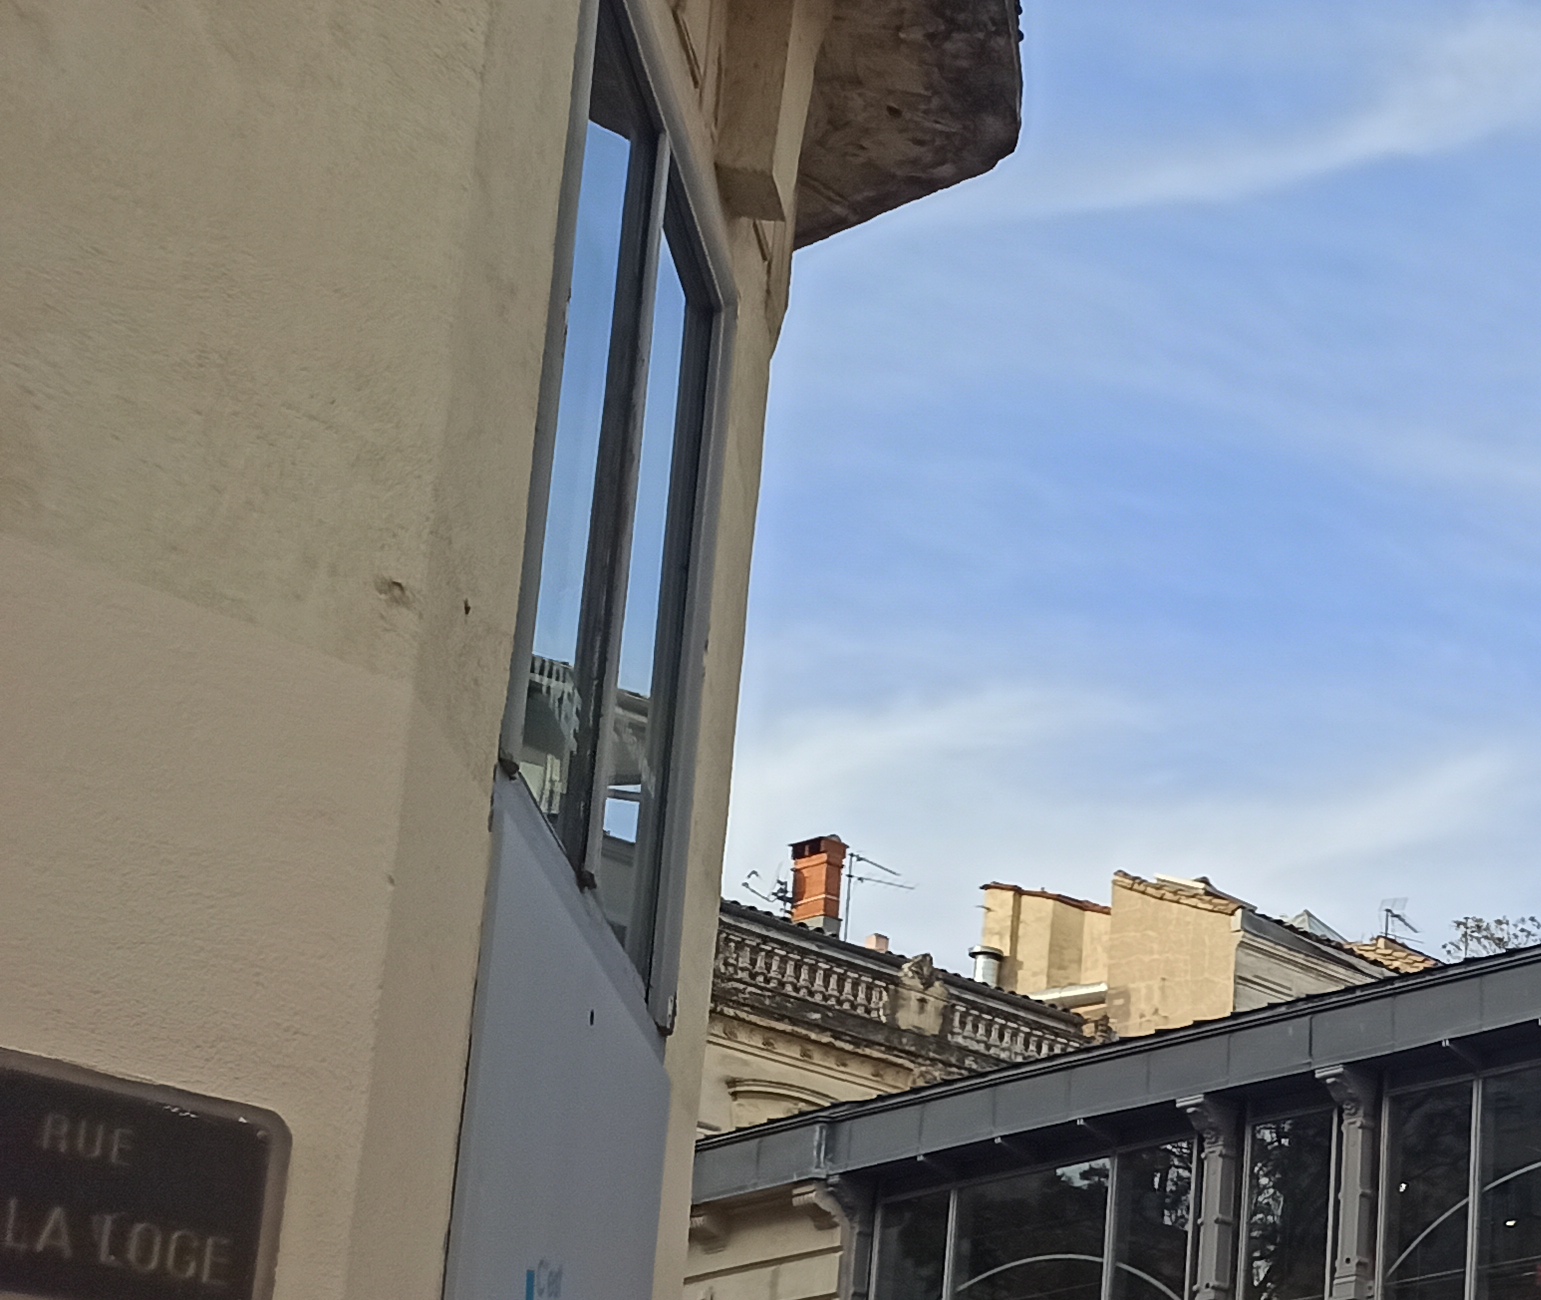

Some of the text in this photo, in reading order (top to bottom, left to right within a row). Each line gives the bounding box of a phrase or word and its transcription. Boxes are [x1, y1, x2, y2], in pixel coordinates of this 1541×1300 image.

[42, 1111, 136, 1167] RUE
[3, 1196, 231, 1287] LA LOGE
